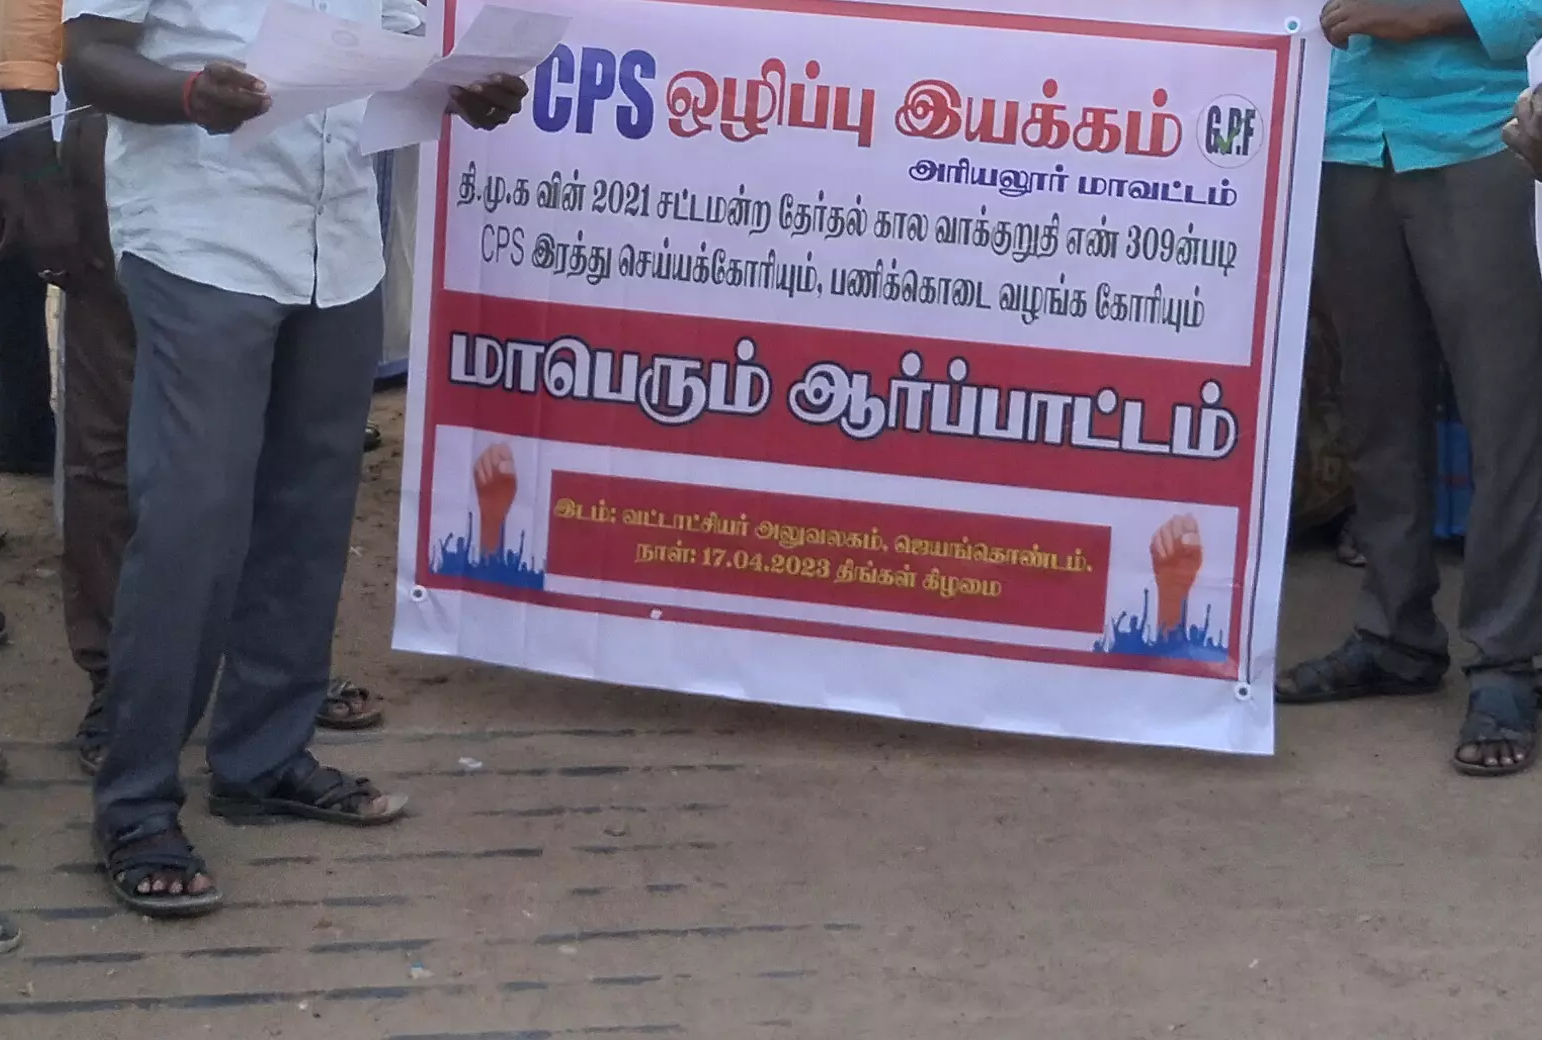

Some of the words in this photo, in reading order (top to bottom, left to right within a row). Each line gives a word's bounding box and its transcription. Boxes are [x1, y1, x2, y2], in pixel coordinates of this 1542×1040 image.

[532, 43, 657, 140] CPS
[666, 57, 876, 148] ஒழிப்பு
[894, 77, 1182, 158] இயக்கம்
[457, 161, 530, 213] தி.மு.க
[537, 168, 585, 212] வின்
[592, 179, 650, 218] 2021
[657, 183, 771, 235] சட்டமன்ற
[779, 189, 868, 240] தேர்தல்
[873, 210, 929, 244] கால
[935, 204, 1059, 263] வாக்குறுதி
[1067, 215, 1119, 260] எண்
[1126, 222, 1238, 275] 309ன்படி
[909, 157, 1069, 197] அரியலூர்
[1078, 177, 1238, 207] மாவட்டம்
[480, 223, 525, 266] CPS
[532, 230, 612, 284] இரத்து
[619, 237, 823, 299] செய்யக்கோரியும்,
[830, 258, 991, 311] பணிக்கொடை
[998, 273, 1087, 325] வழங்க
[1095, 283, 1205, 333] கோரியும்
[448, 331, 772, 423] மாபெரும்
[788, 350, 1239, 461] ஆர்ப்பாட்டம்
[554, 497, 617, 524] இடம்:
[622, 508, 749, 538] வட்டாட்சியர்
[634, 539, 696, 565] நாள்:
[701, 548, 830, 579] 17.04.2023
[833, 557, 917, 590] திங்கள்
